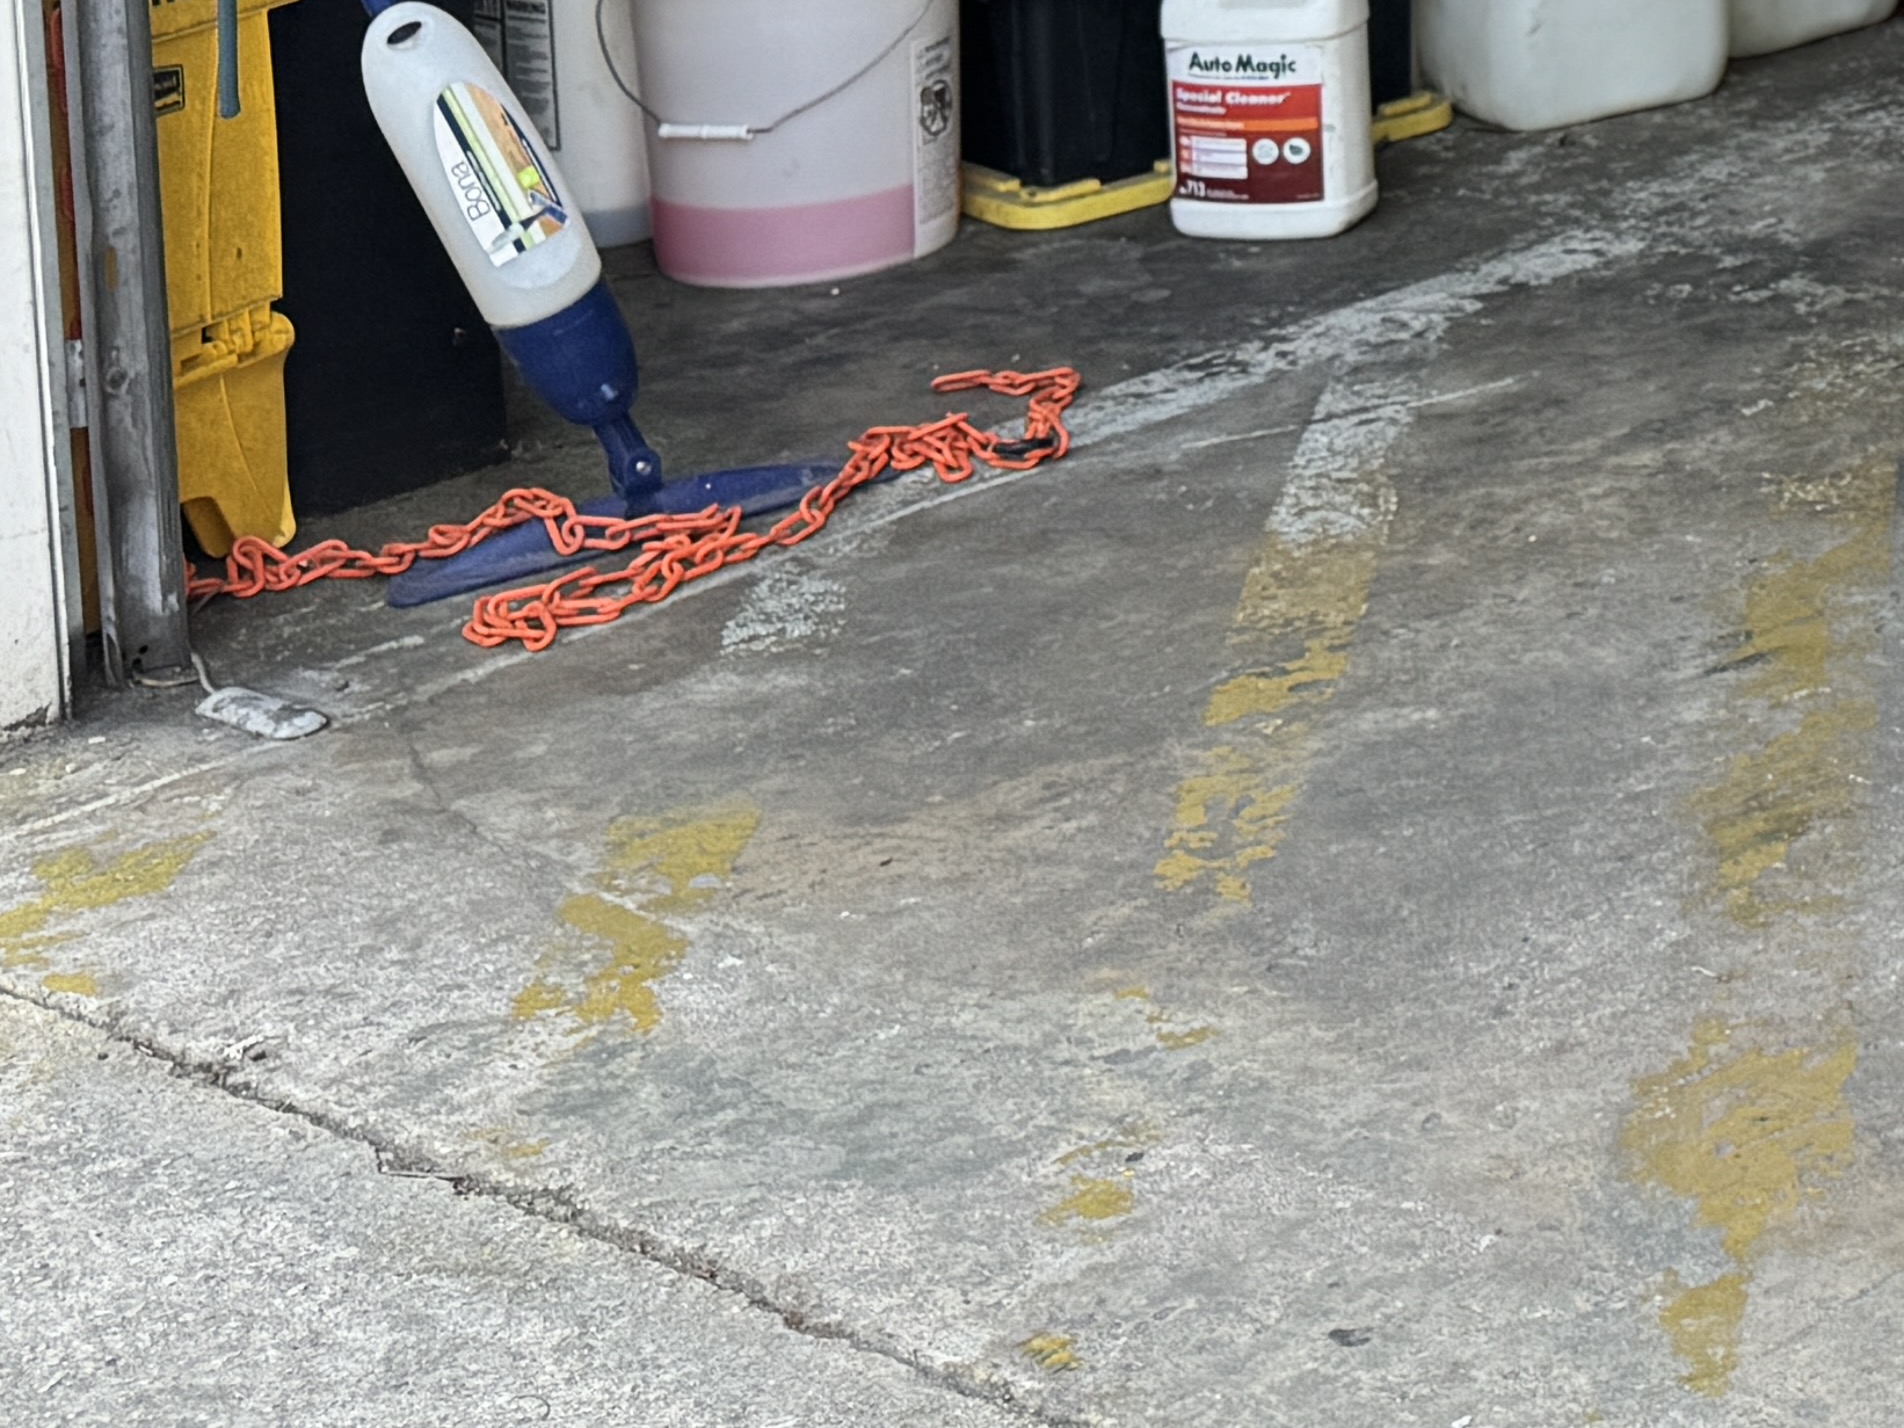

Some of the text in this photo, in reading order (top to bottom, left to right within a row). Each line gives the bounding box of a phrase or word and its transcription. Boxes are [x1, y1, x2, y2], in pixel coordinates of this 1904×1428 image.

[1189, 51, 1297, 80] Auto Magic
[1176, 87, 1222, 104] Special
[451, 160, 491, 222] Bona
